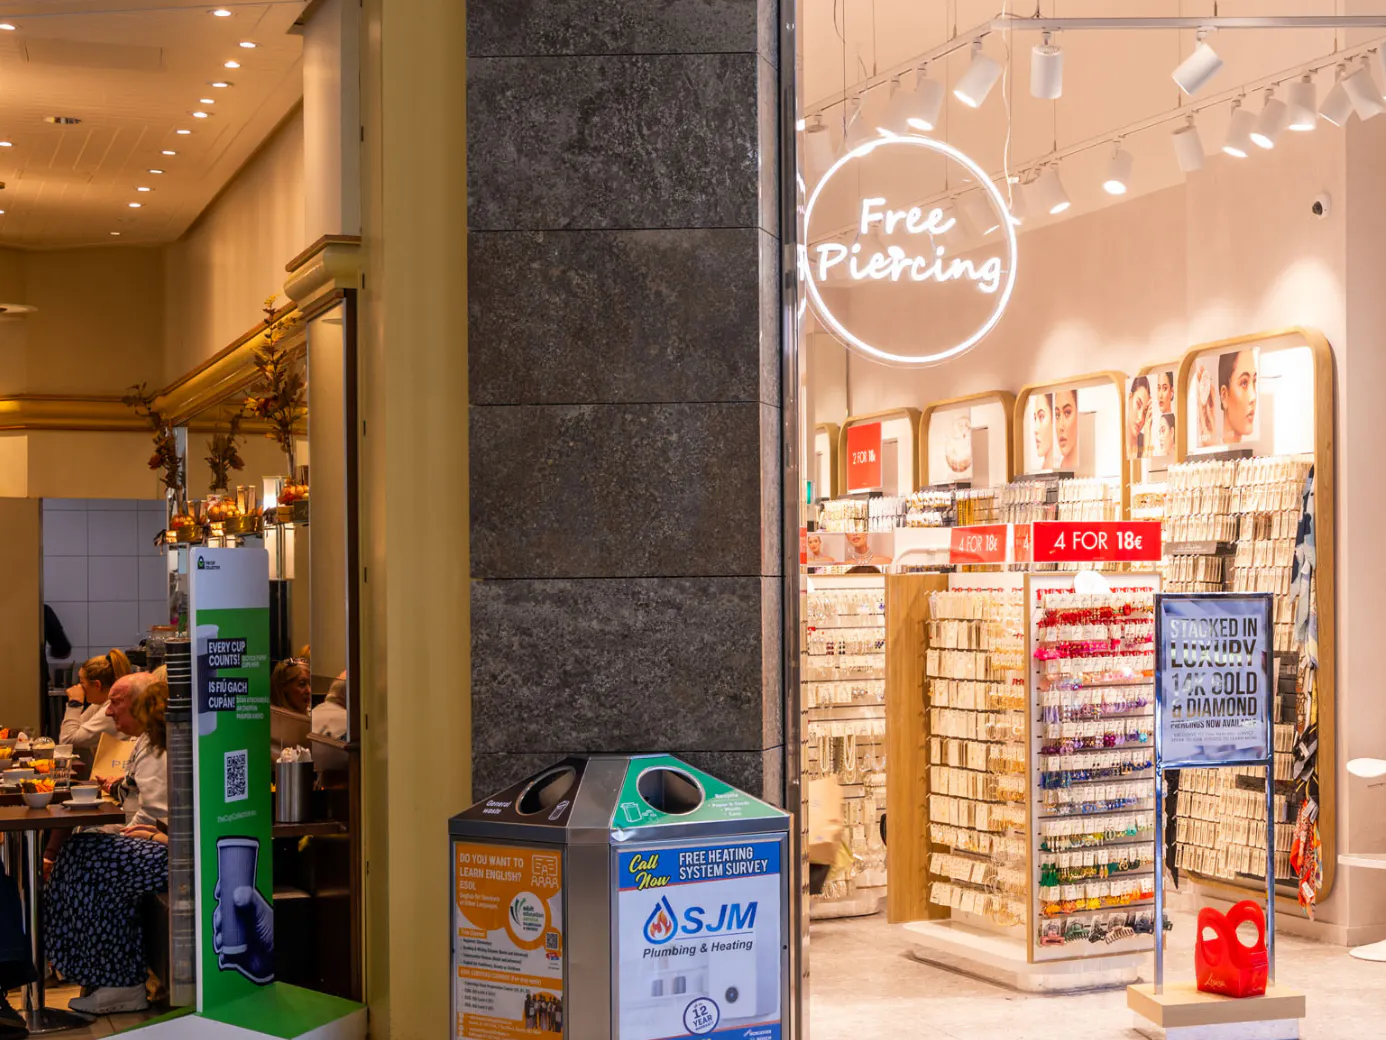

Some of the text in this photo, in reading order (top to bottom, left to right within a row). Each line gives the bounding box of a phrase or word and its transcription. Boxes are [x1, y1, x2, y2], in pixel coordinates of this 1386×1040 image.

[860, 198, 956, 235] Free
[816, 243, 1001, 292] Piercing
[959, 533, 998, 552] 4 FOR 18€
[1054, 531, 1143, 550] 4 FOR 18€
[1170, 617, 1258, 639] STACKED IN
[208, 640, 246, 654] EVERY CUP
[1170, 639, 1257, 668] LUXURY
[208, 654, 241, 667] COUNTS!
[208, 678, 248, 693] IS FIÚ GACH
[1171, 671, 1258, 697] 14K GOLD
[208, 693, 236, 709] CUPÁN!
[1186, 696, 1258, 719] DIAMOND
[1206, 719, 1222, 729] NOW
[486, 800, 513, 808] General
[460, 853, 524, 868] DO YOU WANT TO
[628, 854, 659, 873] Call
[679, 846, 753, 866] FREE HEATING
[460, 867, 522, 882] LEARN ENGLISH?
[679, 859, 768, 880] SYSTEM SURVEY
[460, 880, 476, 891] ESOL
[635, 871, 671, 891] Now
[681, 901, 758, 934] SJM
[642, 940, 753, 958] Plumbing & Heating
[692, 1005, 709, 1019] 12
[693, 1014, 713, 1027] YEAR
